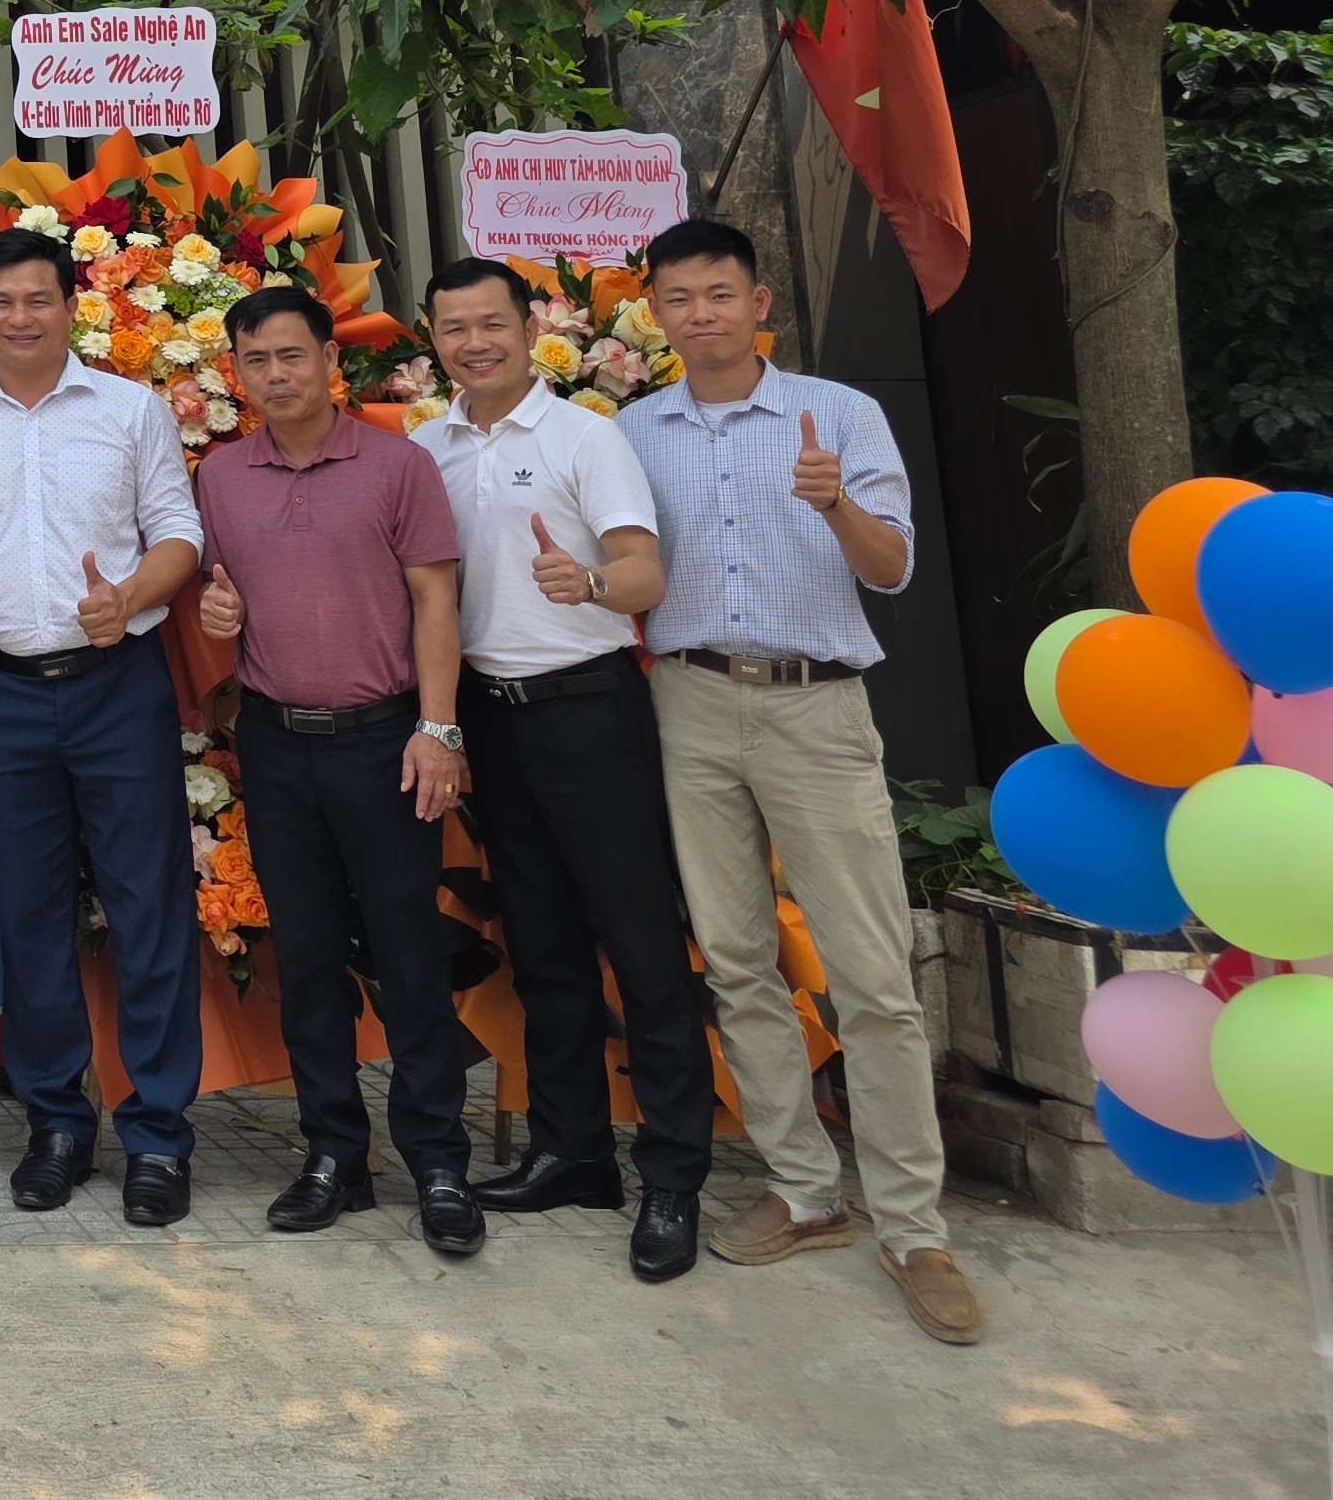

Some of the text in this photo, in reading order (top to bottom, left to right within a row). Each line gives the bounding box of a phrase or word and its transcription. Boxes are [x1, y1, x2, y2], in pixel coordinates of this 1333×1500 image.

[20, 14, 207, 47] Anh Em Sale Nghệ An
[31, 53, 185, 92] Chúc Mừng
[21, 100, 60, 129] K-Edu
[63, 99, 92, 128] Vinh
[95, 98, 125, 127] Phát
[128, 92, 162, 127] Triển
[194, 97, 212, 127] Rỡ
[495, 158, 519, 181] ANH
[522, 158, 542, 186] CHỊ
[544, 158, 568, 182] HUY
[635, 154, 670, 185] QUÂN
[496, 189, 658, 230] Chúc Mừng
[487, 232, 521, 245] KHAI
[525, 232, 583, 246] TRƯƠNG
